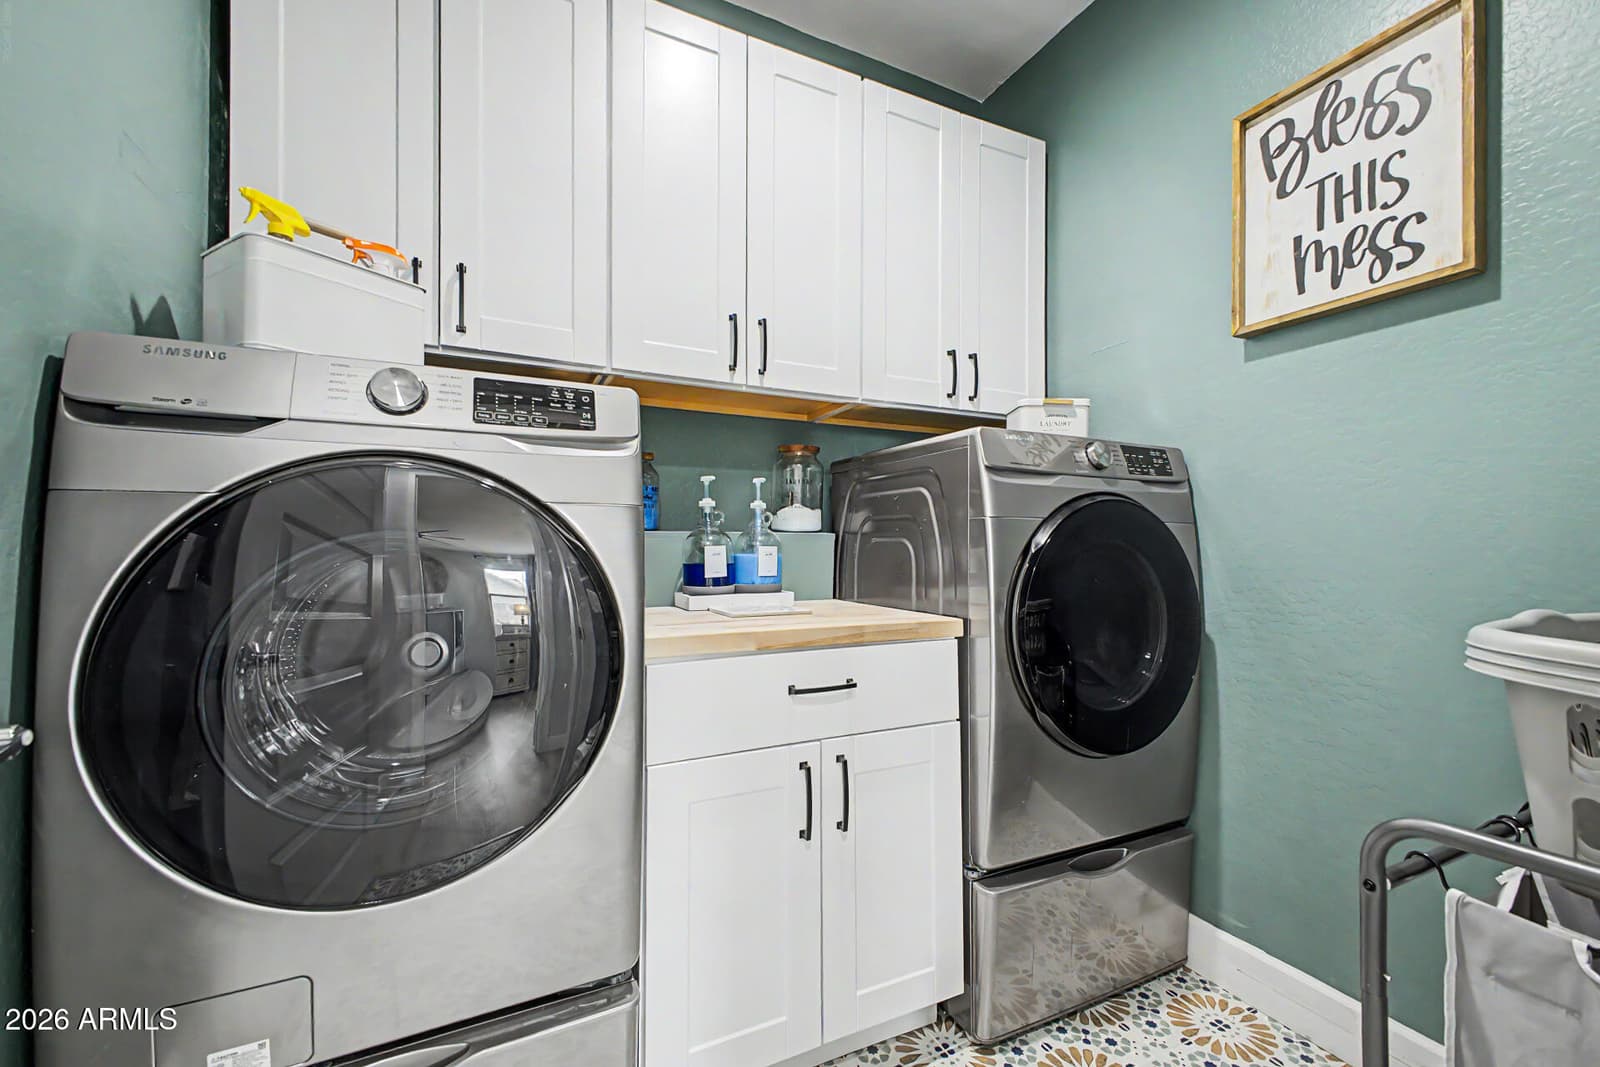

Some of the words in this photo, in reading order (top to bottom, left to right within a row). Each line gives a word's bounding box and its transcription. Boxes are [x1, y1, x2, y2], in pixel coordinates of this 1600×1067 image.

[1259, 53, 1432, 200] Bless
[1305, 149, 1410, 232] THIS
[142, 344, 227, 361] SAMSUNG
